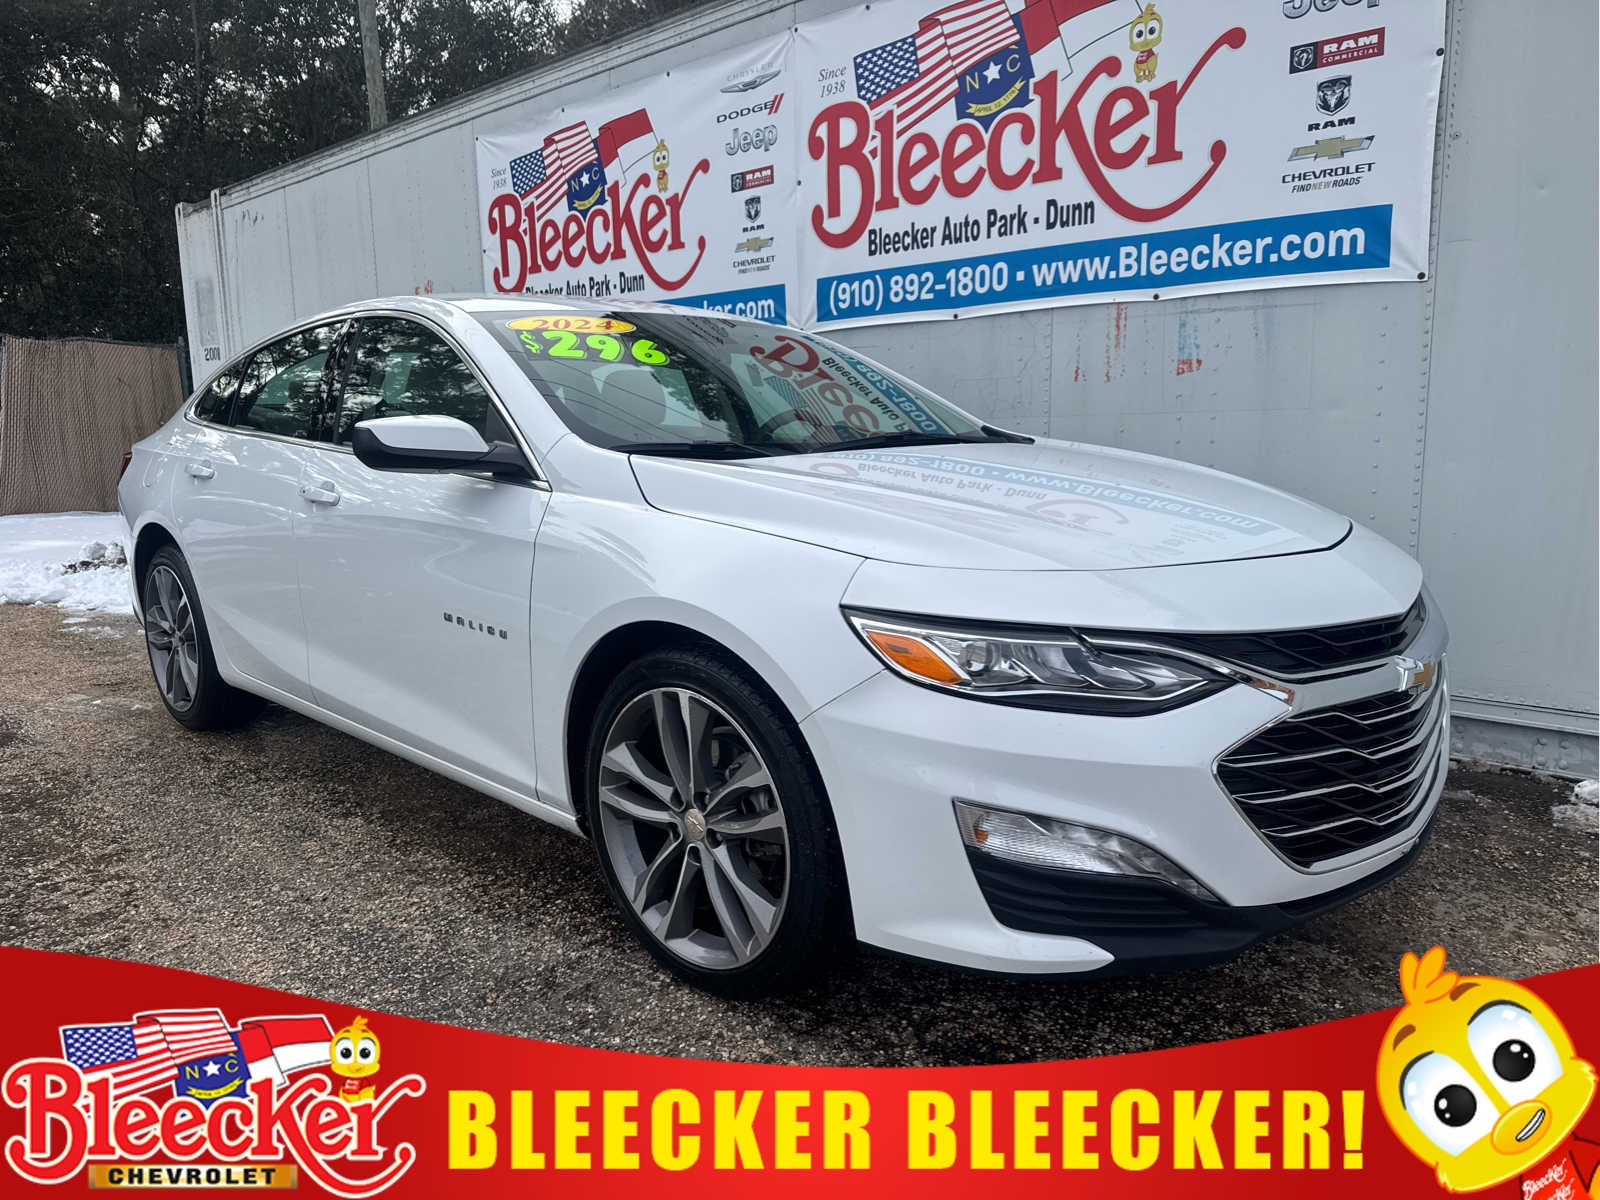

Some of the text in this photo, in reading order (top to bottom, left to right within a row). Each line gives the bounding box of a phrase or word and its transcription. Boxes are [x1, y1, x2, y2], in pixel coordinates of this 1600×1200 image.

[1323, 34, 1378, 54] RAM
[1323, 47, 1378, 63] COMMERCIAL
[818, 65, 847, 82] Since
[965, 54, 1021, 92] N C
[820, 80, 845, 98] 1938
[716, 100, 774, 123] DODGE
[1307, 116, 1356, 132] RAM
[725, 124, 778, 156] Jeep
[808, 26, 1247, 249] Bleecker
[746, 169, 771, 180] RAM
[1282, 162, 1376, 184] CHEVROLET
[488, 158, 710, 292] Bleecker
[742, 224, 765, 232] RAM
[868, 222, 937, 256] Bleecker
[941, 216, 980, 246] Auto
[987, 204, 1028, 238] Park
[1046, 199, 1095, 230] Dunn
[733, 255, 775, 268] CHEVROLET
[829, 226, 1366, 316] (910) 892-1800 www.Bleecker.com
[589, 274, 612, 297] Park
[618, 271, 645, 294] Dunn
[533, 319, 615, 330] 2024
[519, 331, 671, 366] $296
[443, 612, 508, 640] MALIBU
